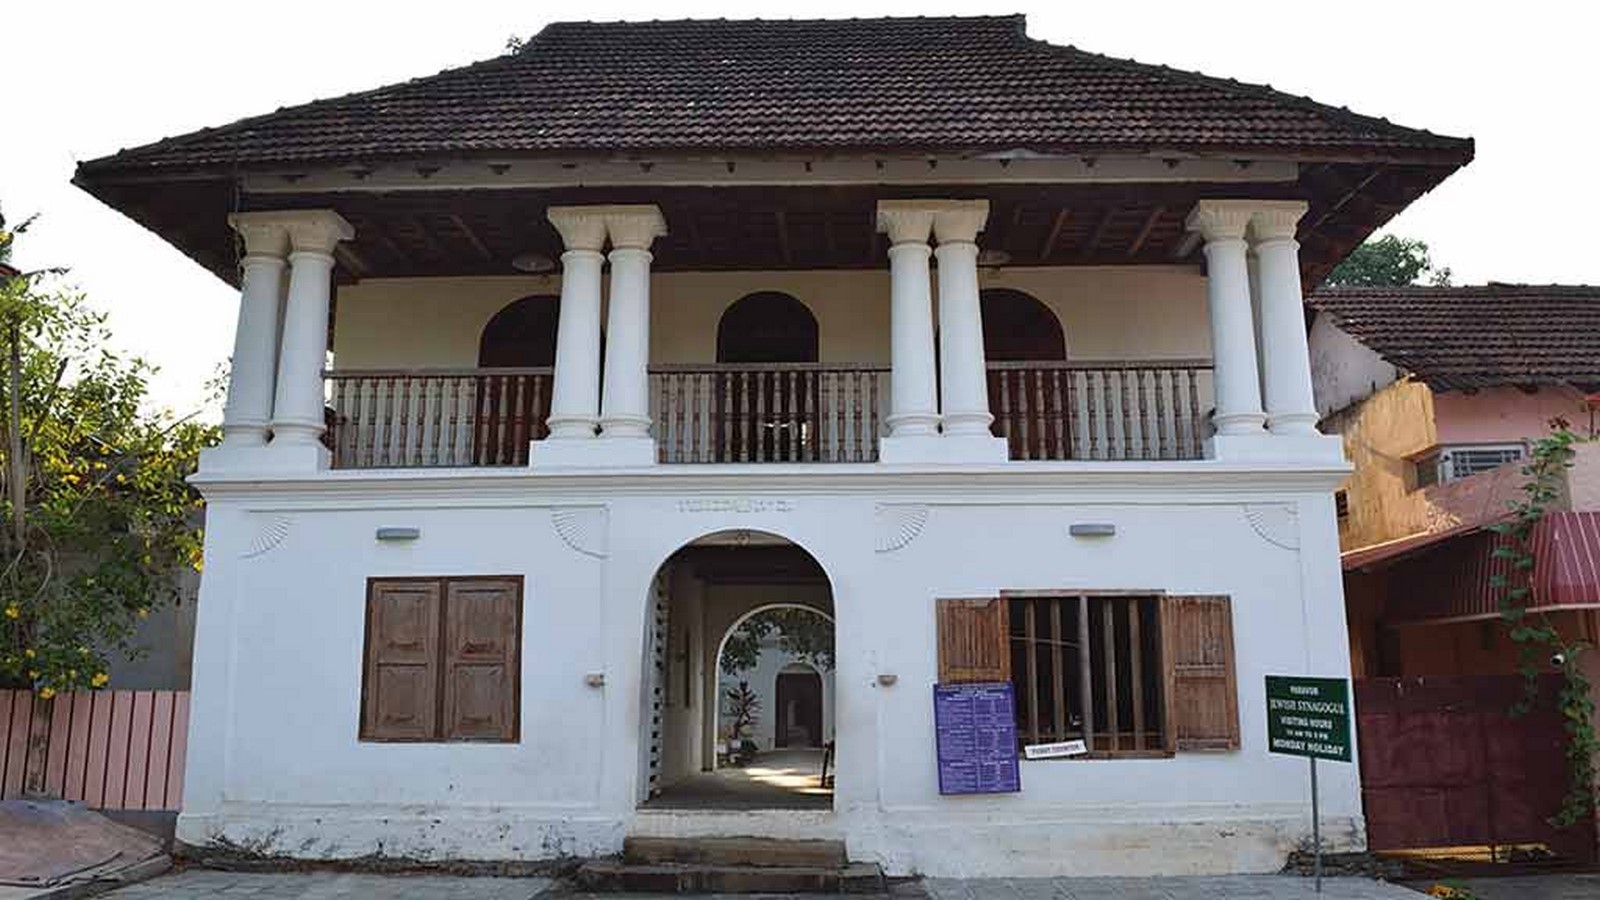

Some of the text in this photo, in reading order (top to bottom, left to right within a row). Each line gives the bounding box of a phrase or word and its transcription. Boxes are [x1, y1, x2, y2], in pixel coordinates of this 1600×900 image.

[1269, 699, 1296, 711] JEWISH
[1273, 738, 1345, 755] MONDAY HOLIDAY
